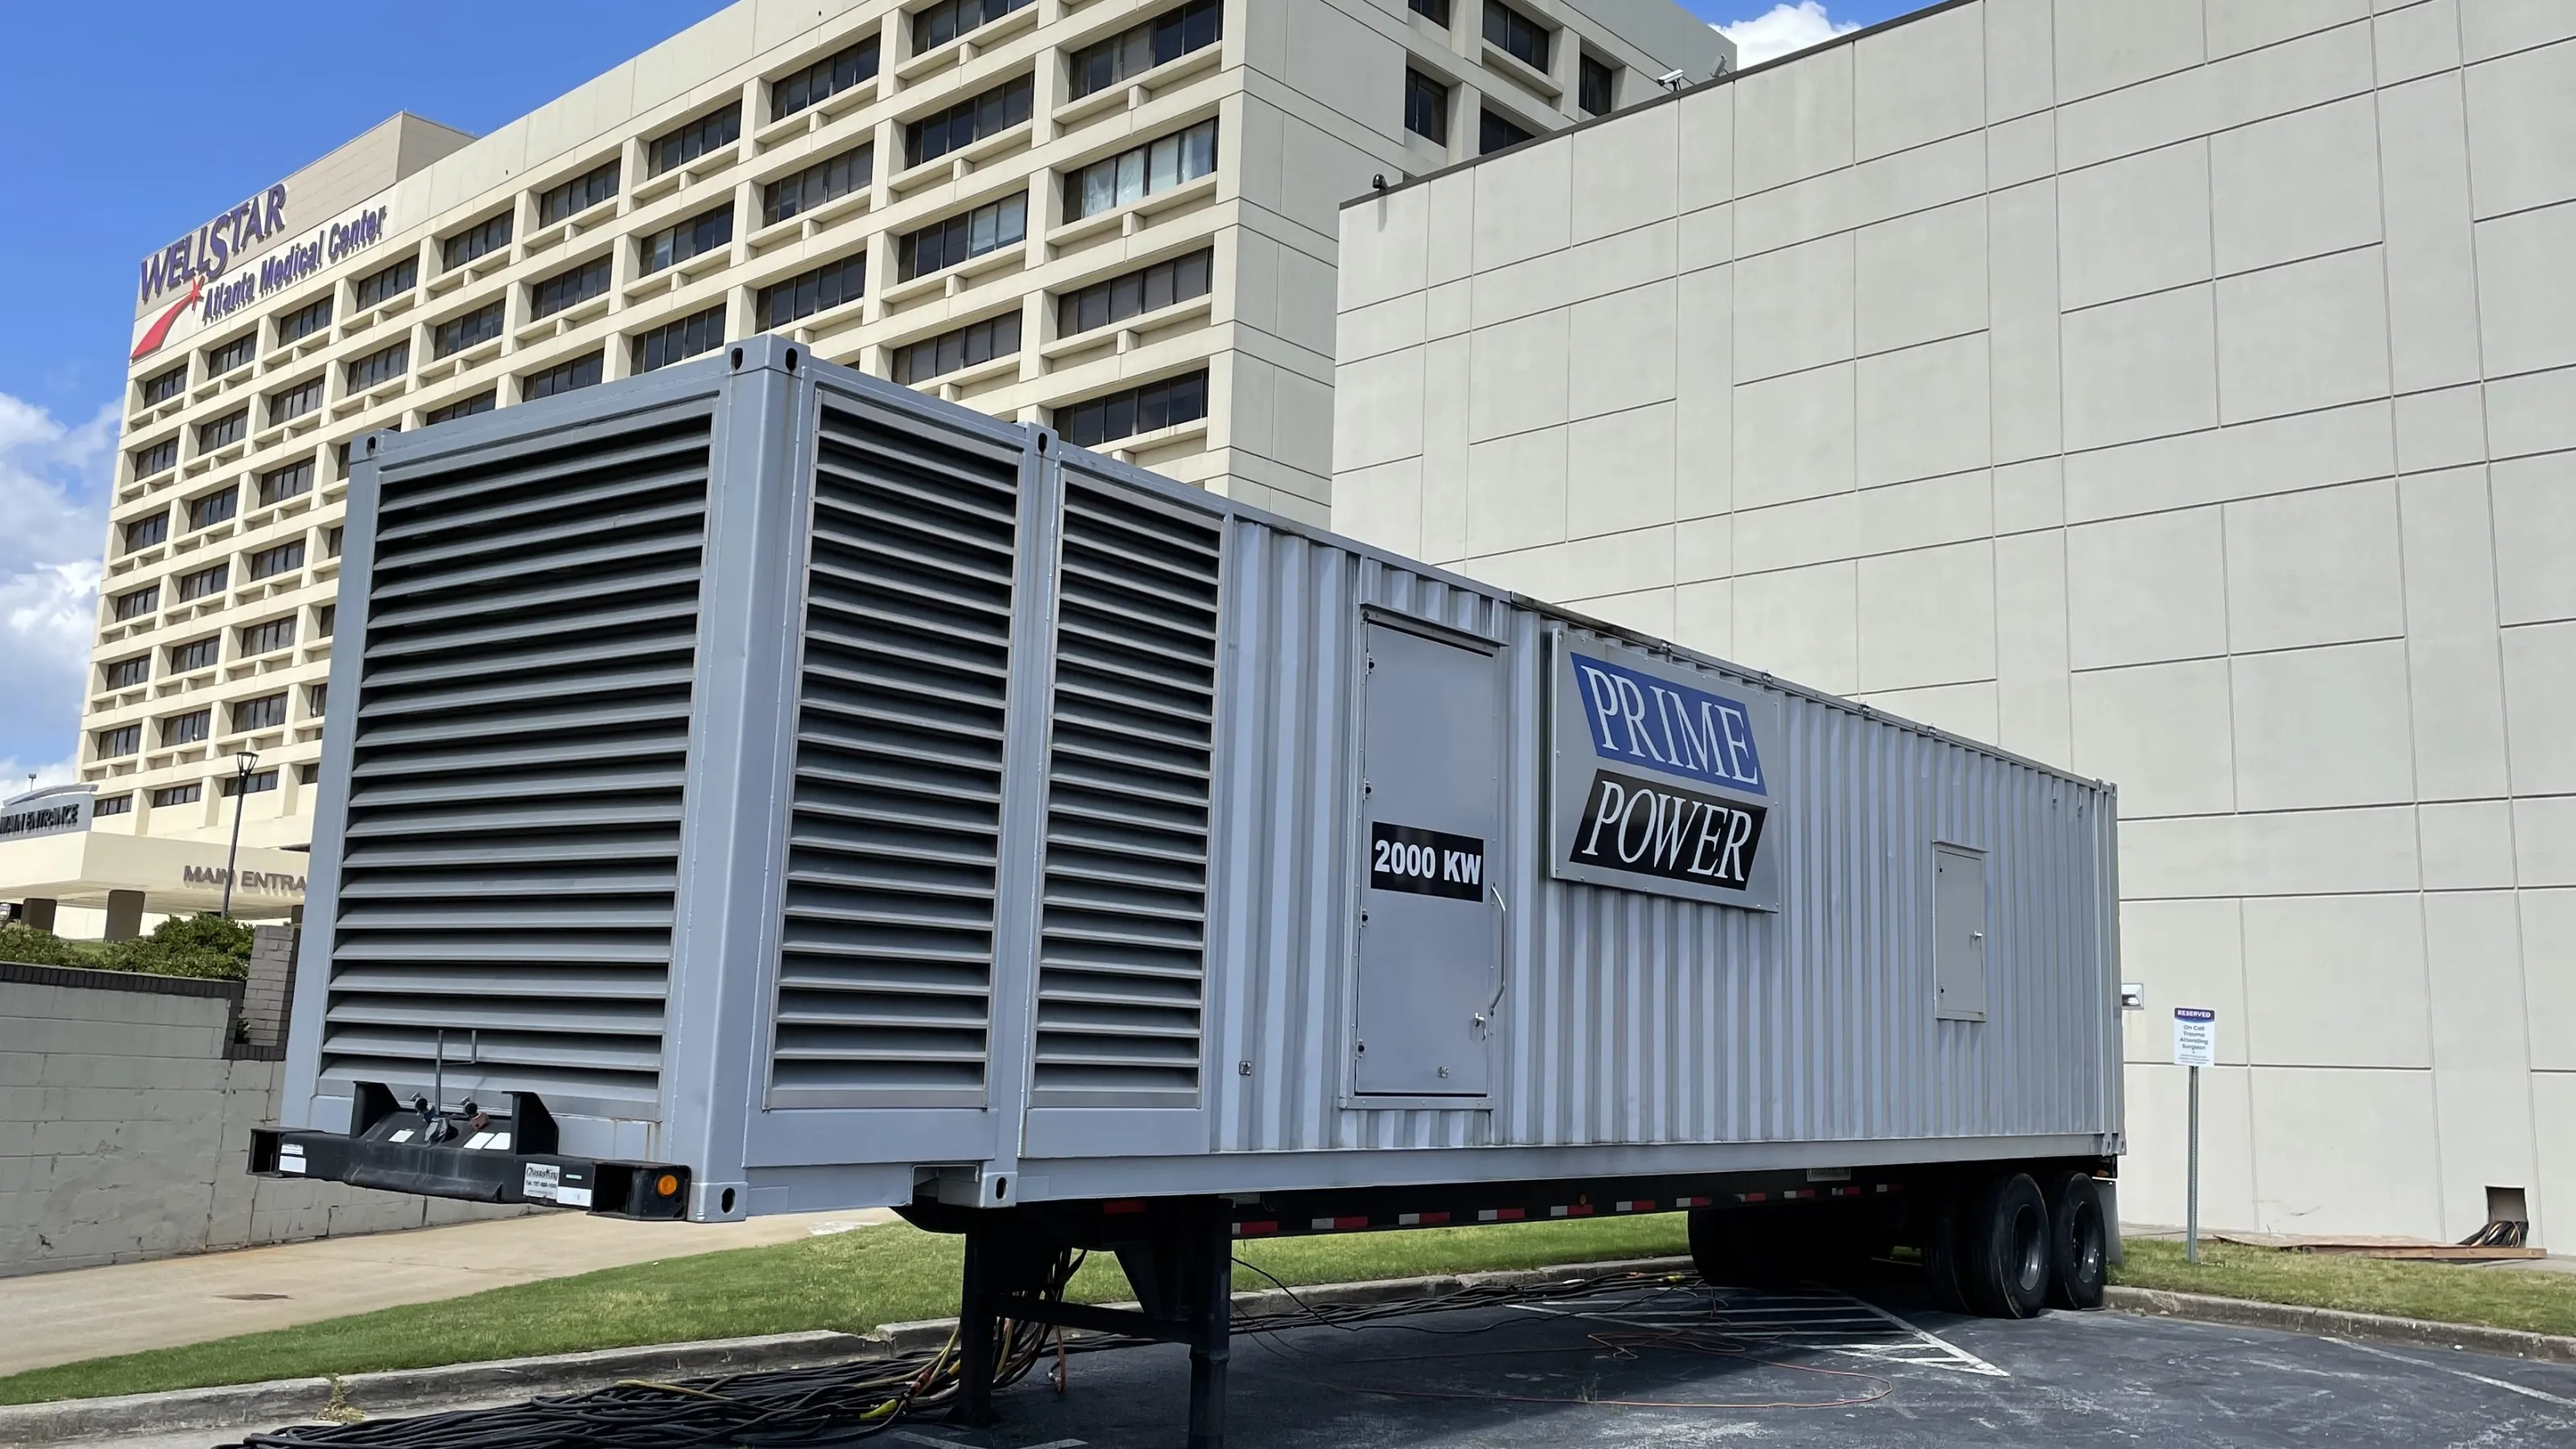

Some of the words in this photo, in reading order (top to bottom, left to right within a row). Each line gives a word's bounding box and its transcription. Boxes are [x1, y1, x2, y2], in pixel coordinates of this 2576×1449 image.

[141, 184, 287, 305] WELLSTAR
[202, 271, 255, 325] Atlanta
[258, 230, 326, 298] Medical
[328, 204, 386, 264] Center
[1580, 665, 1759, 785] PRIME
[25, 803, 80, 830] ENTRANCE
[1373, 840, 1436, 879] 2000
[1443, 849, 1482, 886] KW
[1581, 780, 1752, 882] POWER
[2178, 1009, 2211, 1018] RESERVED
